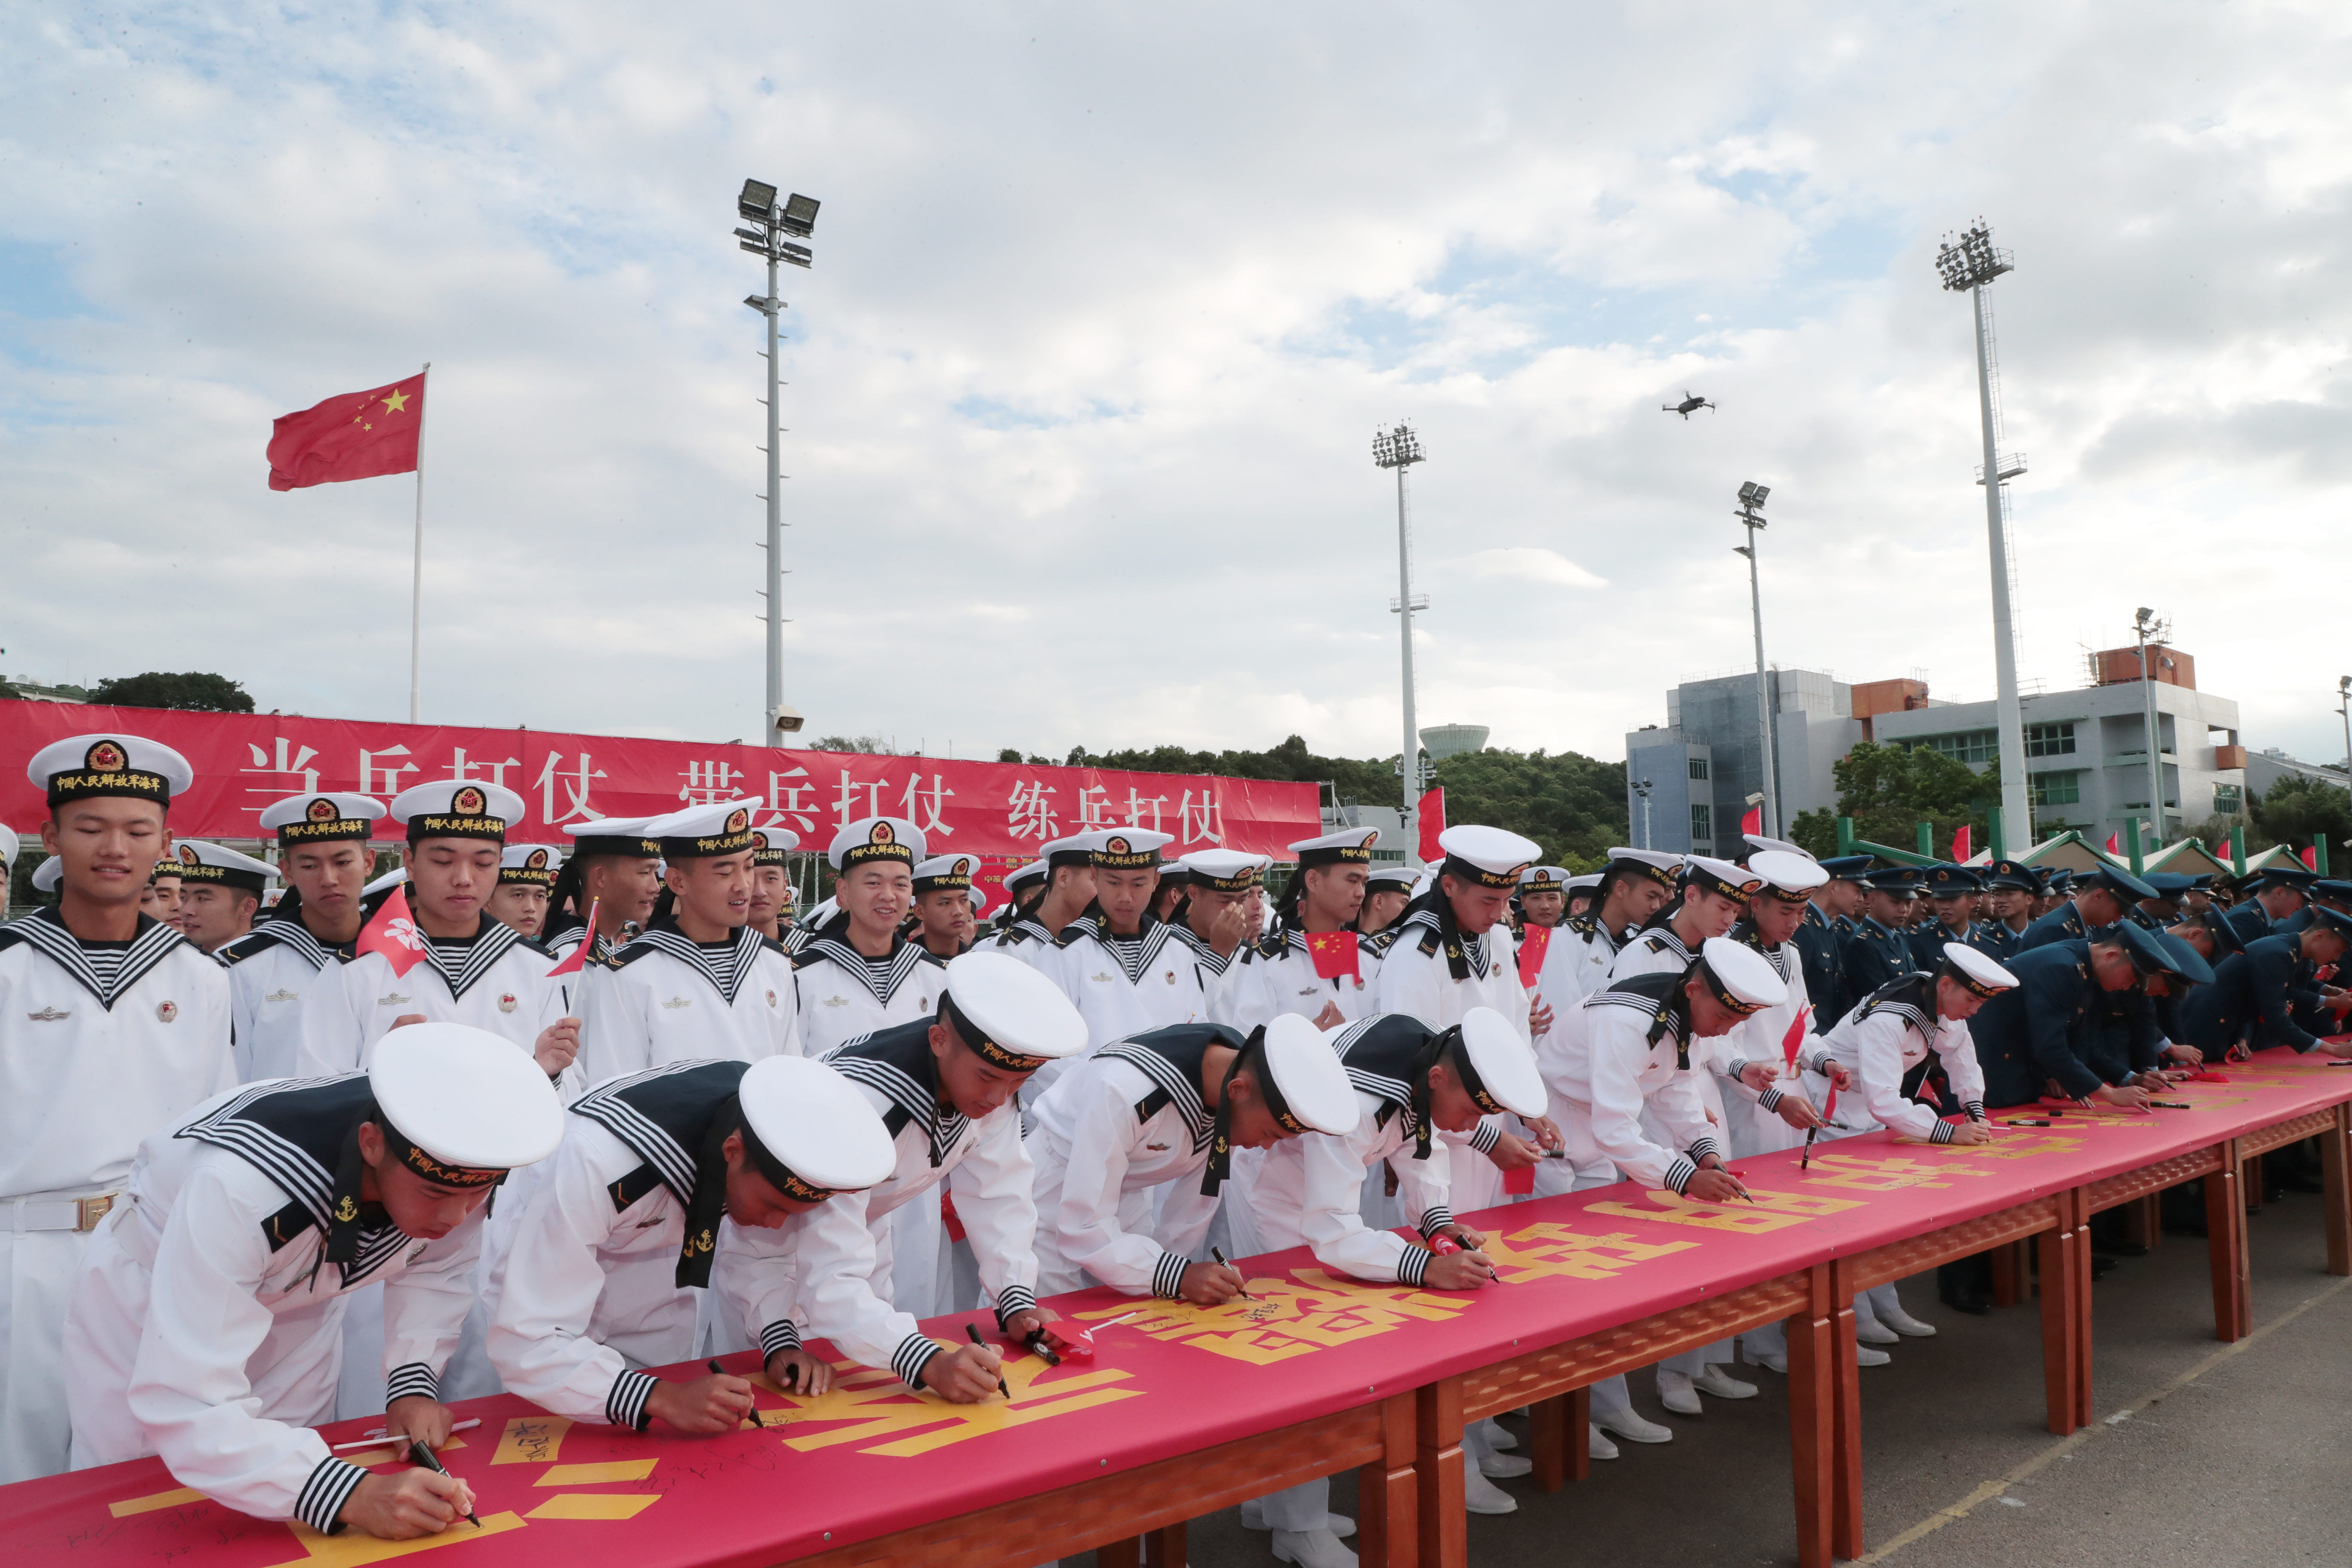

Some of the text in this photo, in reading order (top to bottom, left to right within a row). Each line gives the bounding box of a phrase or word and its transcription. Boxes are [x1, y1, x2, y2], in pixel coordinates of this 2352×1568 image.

[57, 774, 160, 792] 中国人民解放军海军
[1008, 780, 1222, 845] 练兵打仗
[286, 820, 363, 838] 中国人民解放军海军
[425, 817, 505, 834] 中国人民解放军海军
[851, 845, 910, 859] 中国人民解放军海军
[1094, 851, 1151, 866] 中国人民解放军海军
